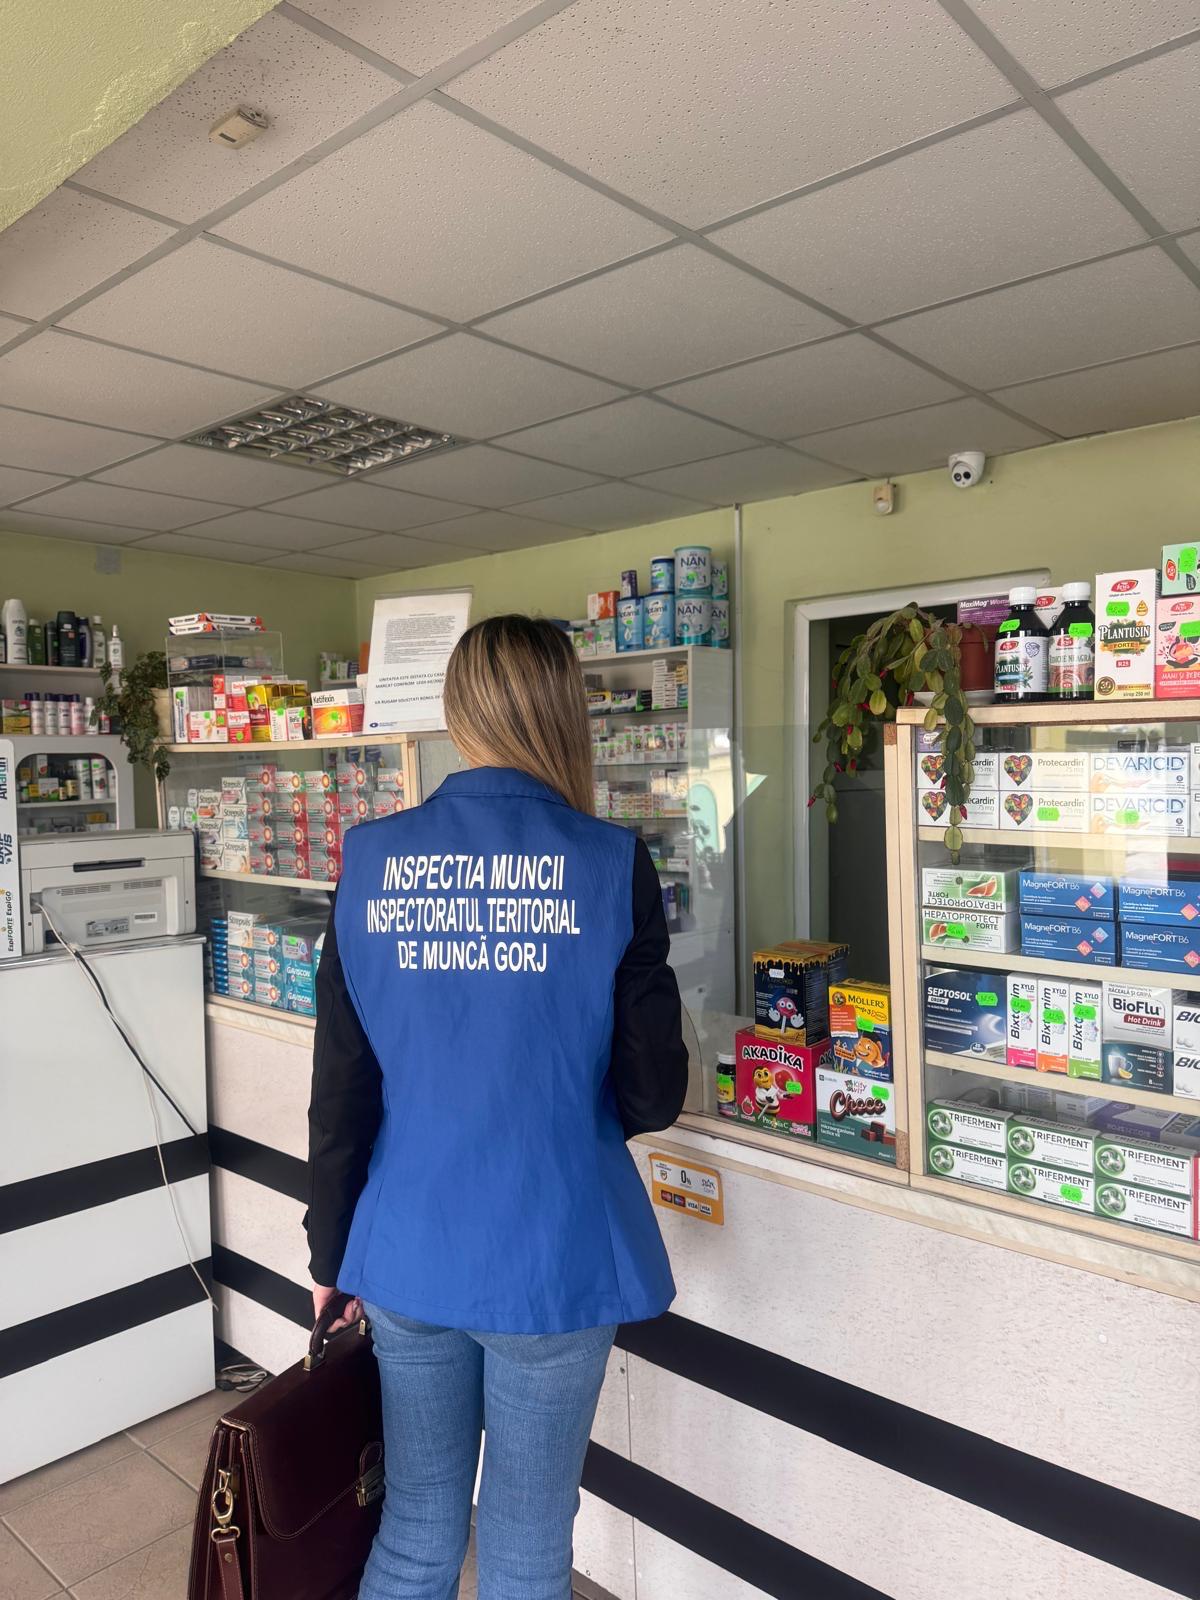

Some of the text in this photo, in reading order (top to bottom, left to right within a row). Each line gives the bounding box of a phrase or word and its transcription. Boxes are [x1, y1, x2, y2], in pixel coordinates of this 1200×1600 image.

[680, 557, 706, 567] NAN
[677, 605, 702, 615] NAN
[1099, 625, 1150, 641] PLANTUSIN
[383, 855, 565, 890] INSPECTIA MUNCII
[927, 898, 1003, 910] HEPATOPROTECT
[367, 897, 580, 934] INSPECTORATUL TERITORIAL
[924, 911, 1000, 924] HEPATOPROTECT
[976, 923, 999, 931] FORTE
[398, 940, 418, 970] DE
[494, 942, 547, 972] GORJ
[927, 986, 972, 1002] SEPTOSOL
[1020, 983, 1035, 991] XYLO
[1112, 997, 1160, 1016] BioFlu
[1127, 1015, 1162, 1027] Hot Drink
[830, 1089, 886, 1121] Choco
